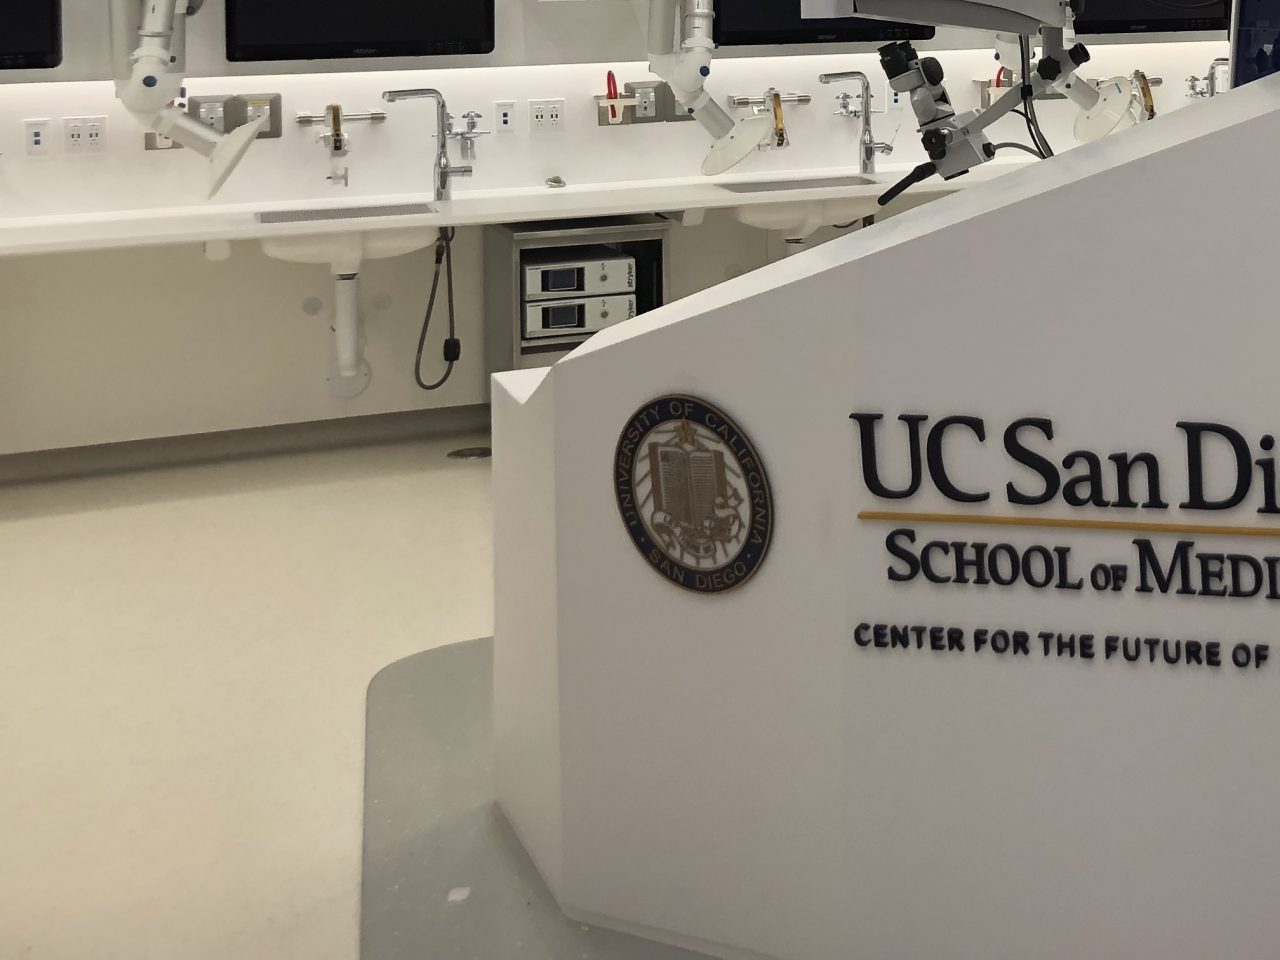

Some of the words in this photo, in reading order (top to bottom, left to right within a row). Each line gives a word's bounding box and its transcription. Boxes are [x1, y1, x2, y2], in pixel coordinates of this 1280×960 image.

[617, 405, 660, 527] UNIVERSITY
[669, 401, 694, 416] OF
[705, 412, 767, 545] CALIFORNIA
[848, 413, 990, 503] UC
[1003, 417, 1169, 509] San
[649, 547, 685, 583] SAN
[695, 561, 747, 589] DIEGO
[885, 528, 1084, 590] SCHOOL
[1090, 563, 1128, 592] OF
[853, 622, 965, 652] CENTER
[973, 628, 1030, 656] FOR
[1038, 632, 1095, 659] THE
[1104, 635, 1222, 667] FUTURE
[1232, 642, 1270, 669] OF
